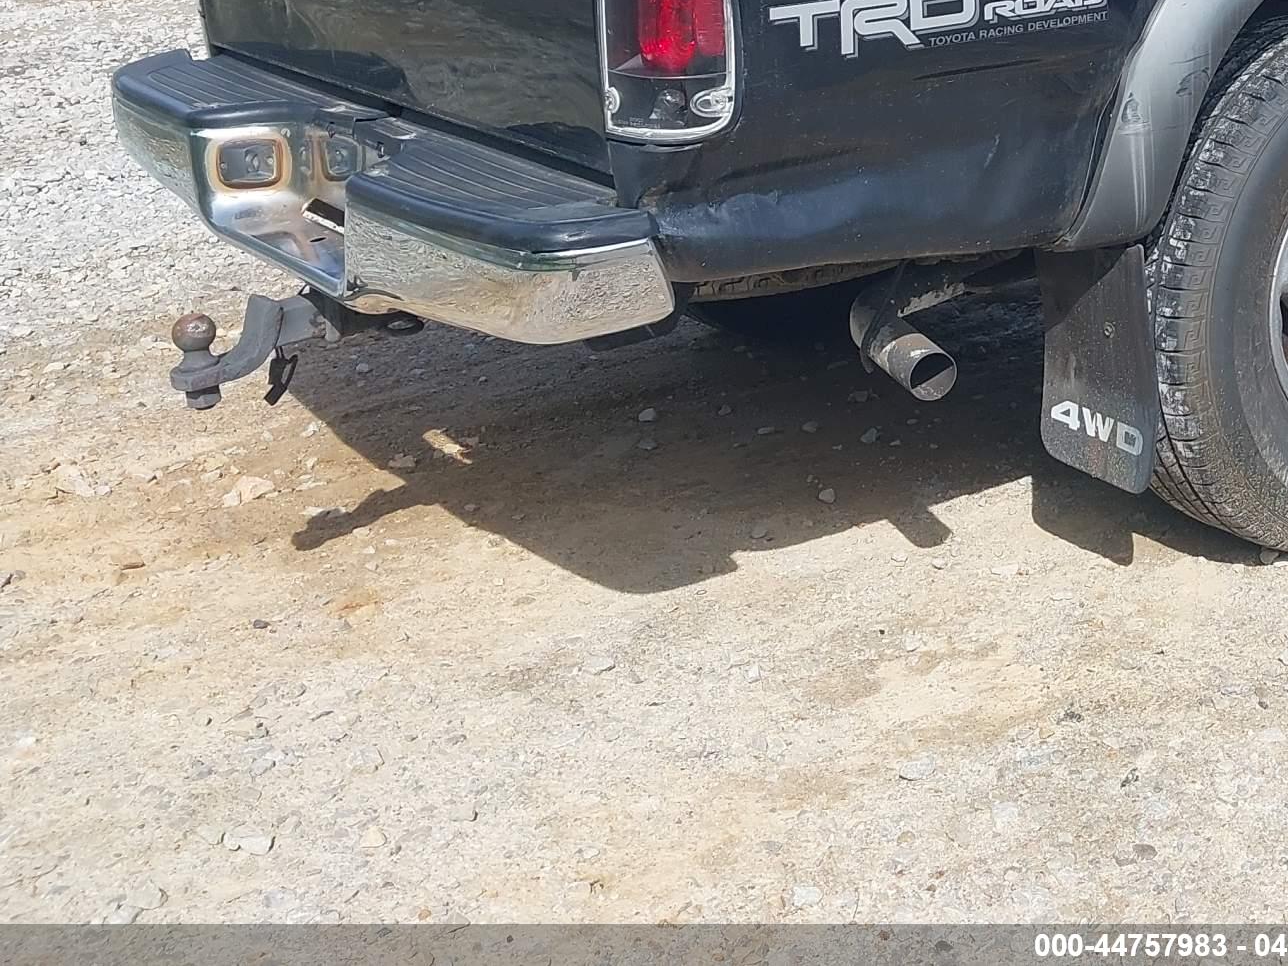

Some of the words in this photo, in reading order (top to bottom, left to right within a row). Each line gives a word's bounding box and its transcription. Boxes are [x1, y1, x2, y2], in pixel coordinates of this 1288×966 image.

[928, 31, 976, 47] TOYOTA
[979, 23, 1024, 39] RACING
[1027, 10, 1108, 31] DEVELOPMENT
[1051, 400, 1144, 456] 4WD
